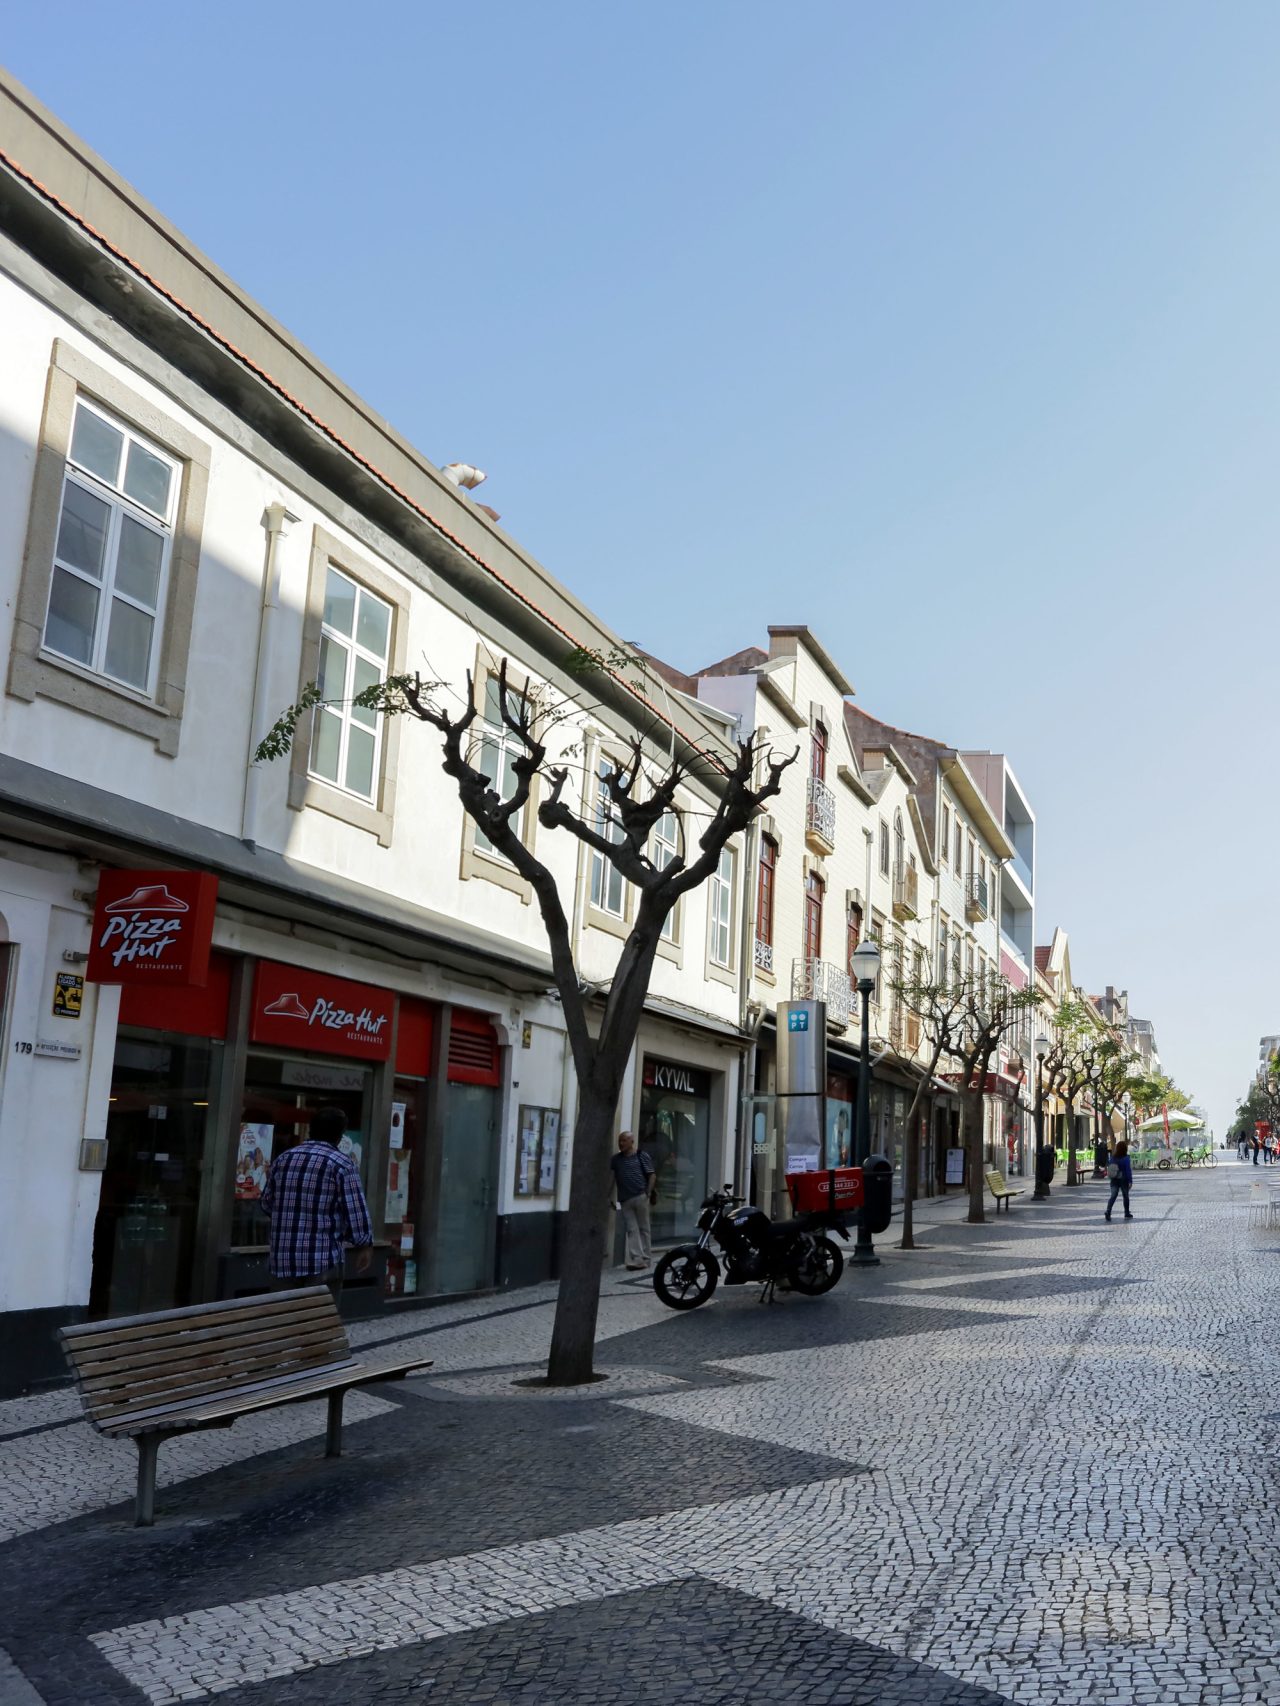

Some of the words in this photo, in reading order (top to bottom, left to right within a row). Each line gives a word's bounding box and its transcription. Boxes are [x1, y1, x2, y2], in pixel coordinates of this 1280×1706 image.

[100, 912, 182, 948] Pizza
[112, 936, 177, 967] Hut
[309, 998, 355, 1030] Pizza
[356, 1008, 388, 1034] Hut
[791, 1021, 806, 1030] PT
[15, 1042, 33, 1054] 179
[347, 1031, 383, 1044] RESTAURANTE
